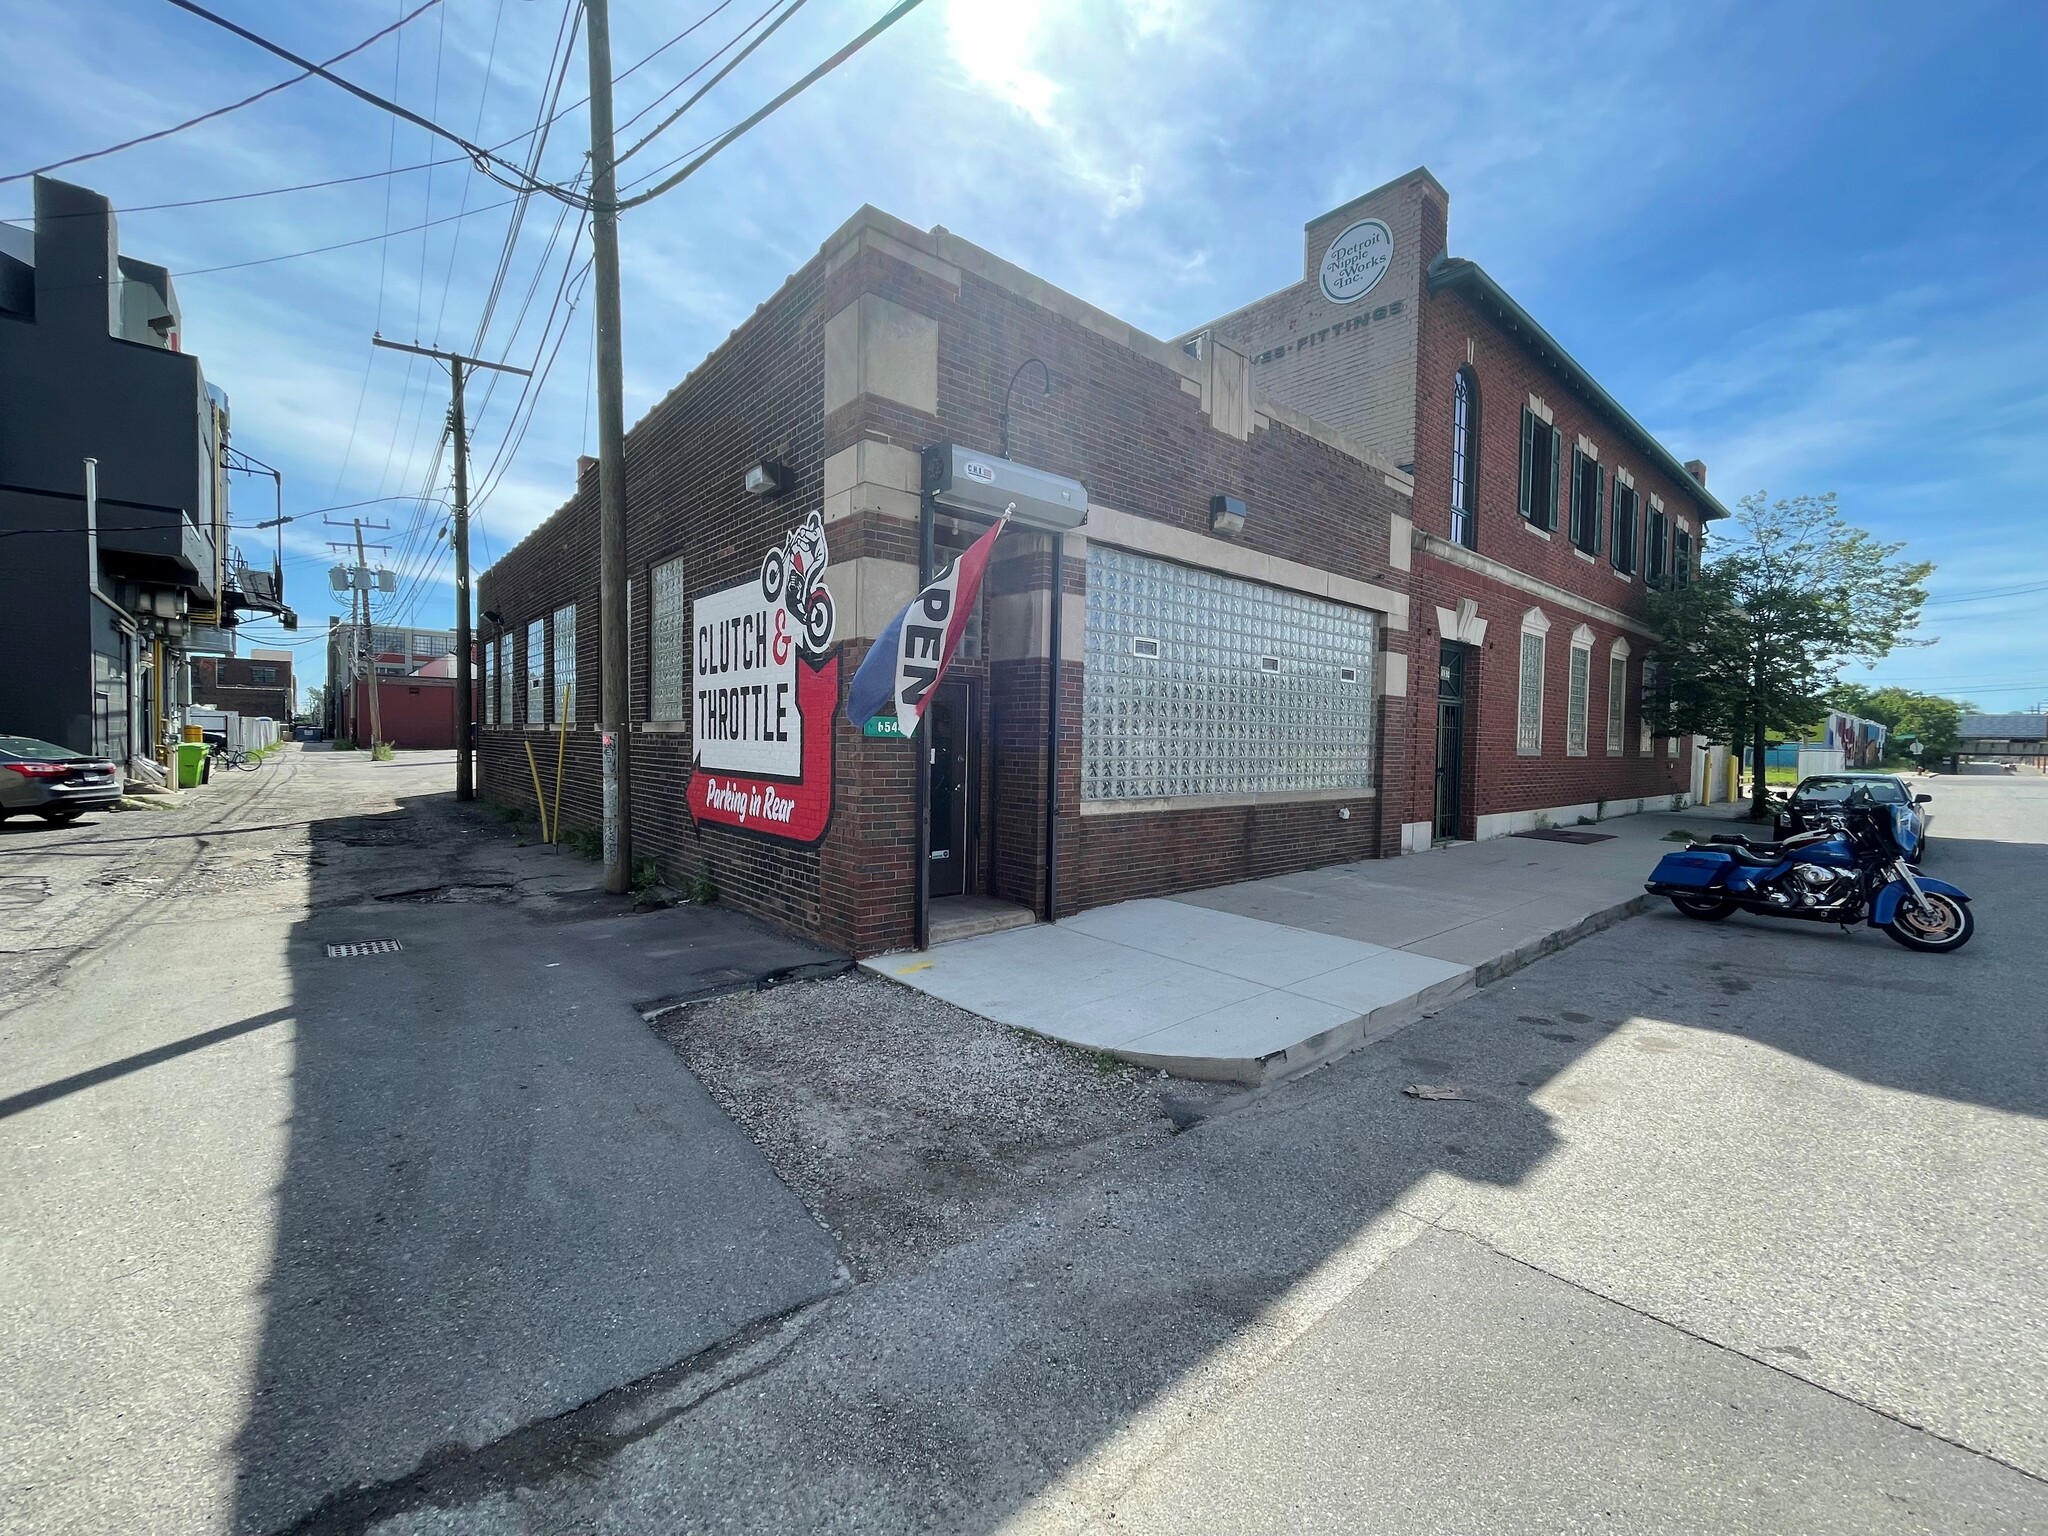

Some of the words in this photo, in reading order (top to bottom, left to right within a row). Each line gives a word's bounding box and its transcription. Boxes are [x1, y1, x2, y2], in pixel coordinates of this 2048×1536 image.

[1327, 250, 1369, 272] Nipple
[1331, 233, 1380, 261] Detroit
[1339, 254, 1387, 278] Works
[1333, 274, 1364, 289] Inc.
[699, 611, 767, 676] CLUTCH
[772, 608, 792, 666] &
[698, 683, 789, 742] THROTTLE
[706, 778, 748, 823] Parking
[749, 785, 762, 817] in
[763, 785, 795, 823] Rear
